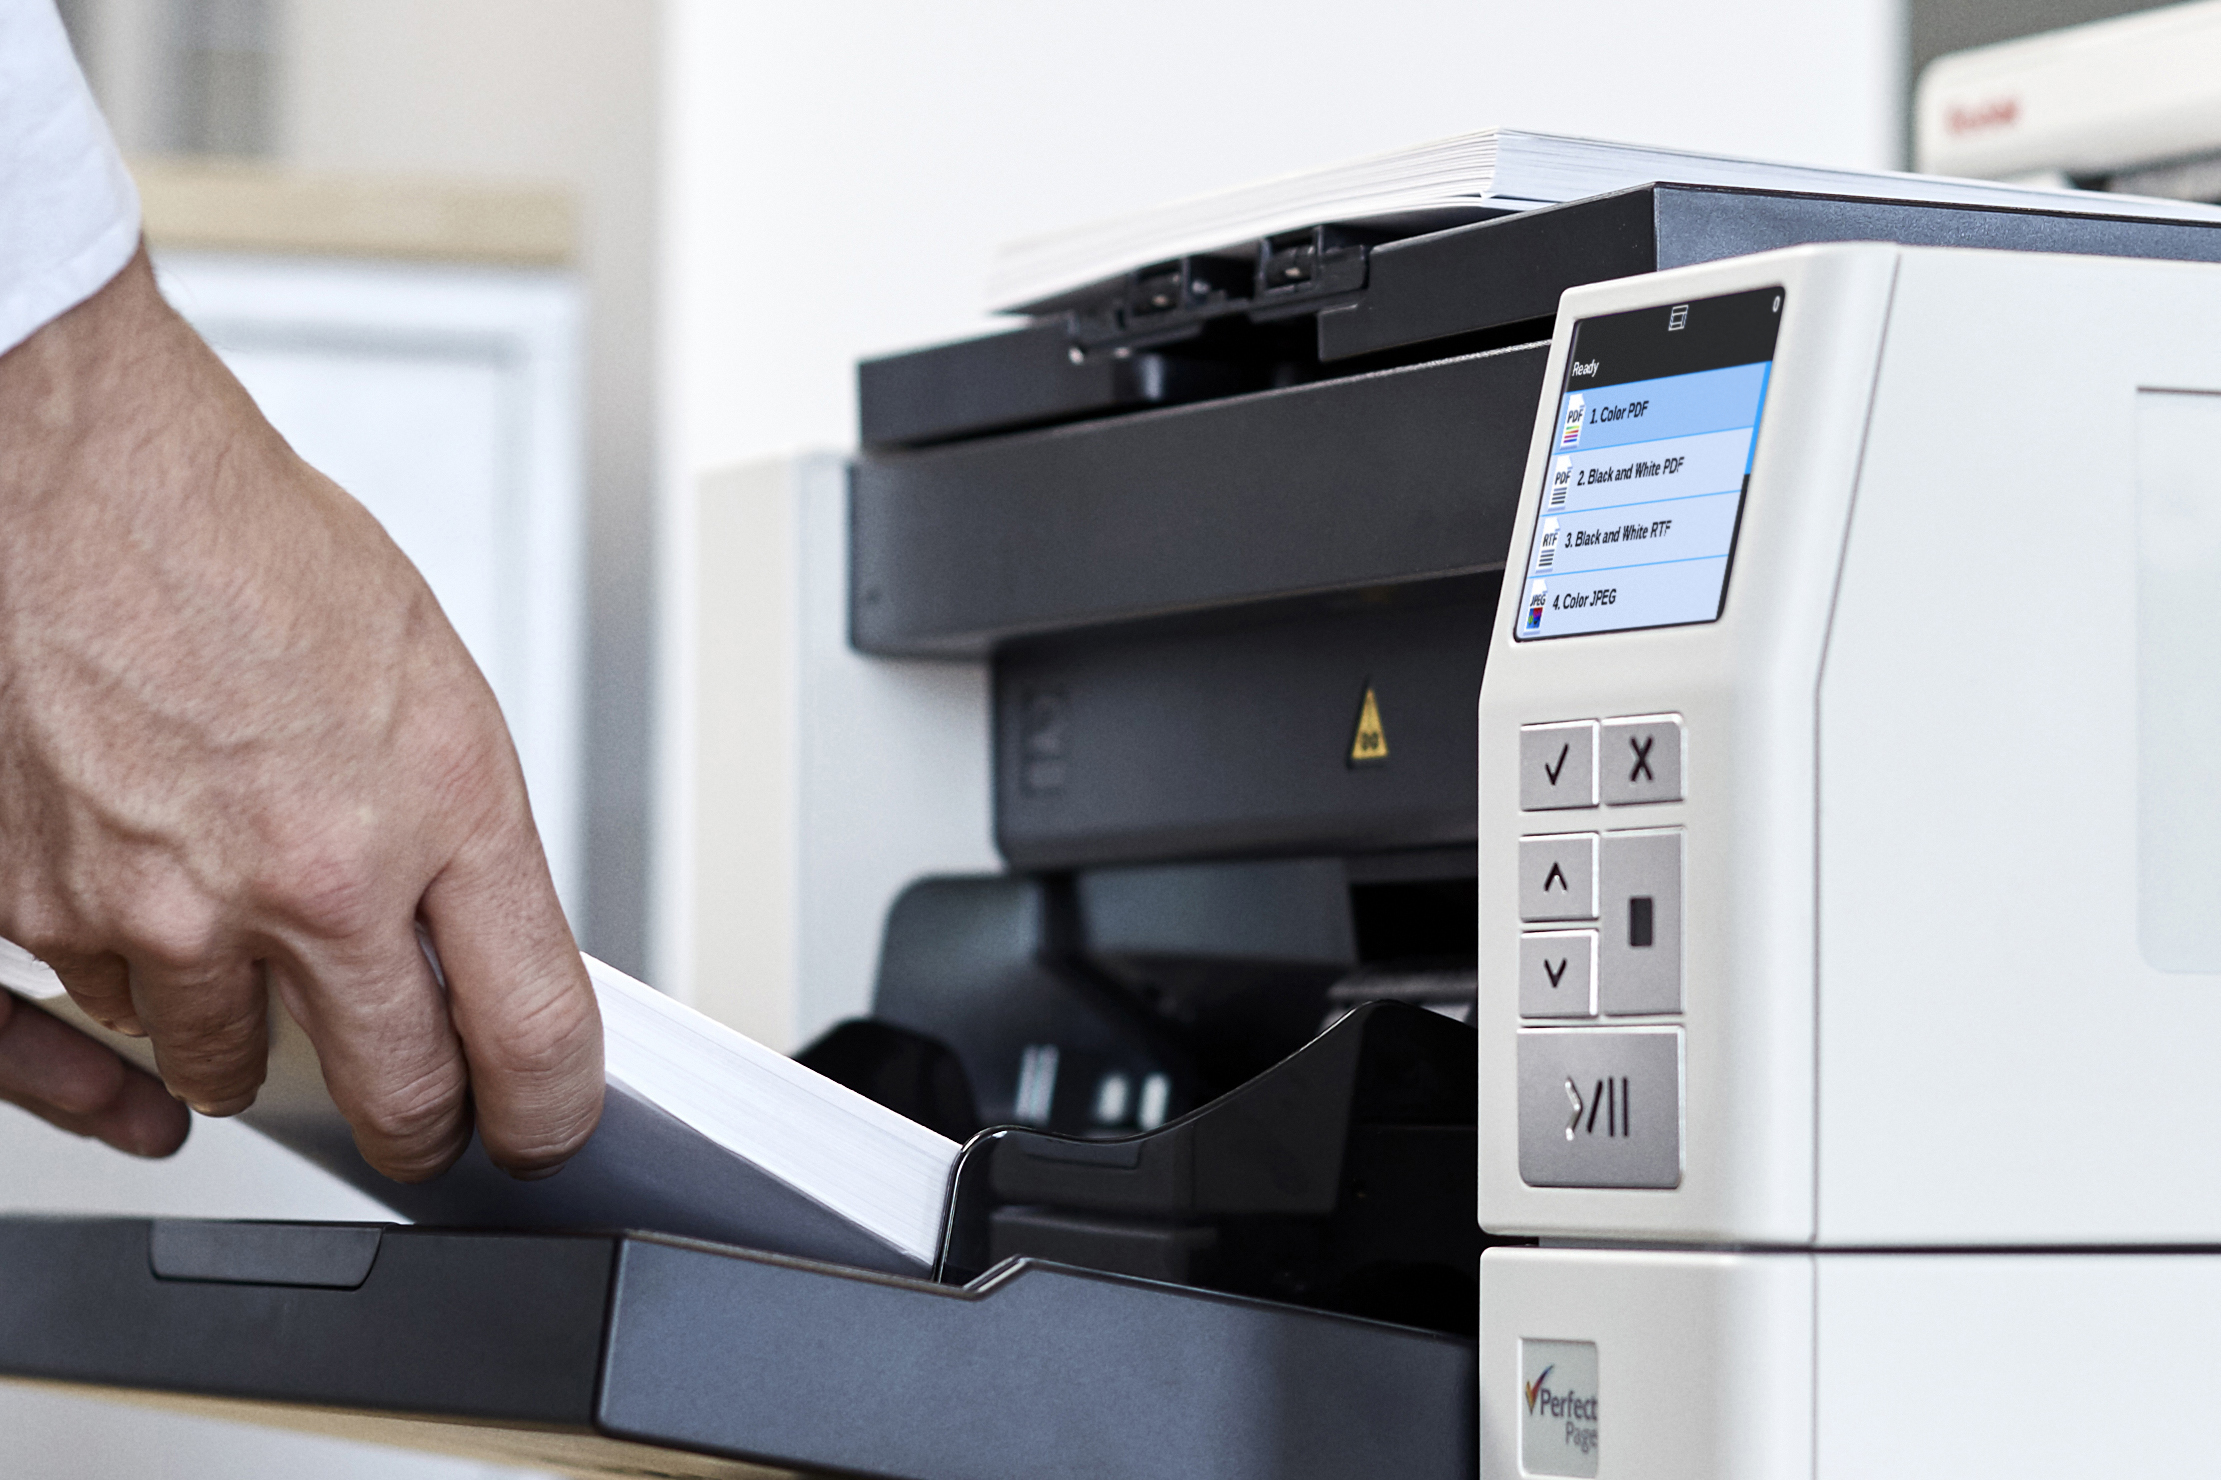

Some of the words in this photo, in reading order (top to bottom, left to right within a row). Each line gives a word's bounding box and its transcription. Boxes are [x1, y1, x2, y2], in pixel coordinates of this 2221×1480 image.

[1572, 359, 1599, 377] Ready
[1567, 409, 1583, 424] PDF
[1590, 408, 1598, 424] 1.
[1600, 405, 1627, 423] Color
[1627, 400, 1649, 418] PDF
[1555, 470, 1571, 485] PDF
[1577, 470, 1586, 486] 2.
[1588, 466, 1614, 485] Black
[1615, 463, 1634, 481] and
[1634, 460, 1661, 479] White
[1662, 456, 1685, 475] PDF
[1542, 532, 1558, 547] RTF
[1564, 532, 1573, 549] 3.
[1575, 529, 1600, 547] Black
[1602, 526, 1621, 543] and
[1622, 522, 1648, 542] White
[1650, 519, 1672, 538] RTF
[1530, 593, 1547, 607] JPEG
[1552, 594, 1561, 611] 4.
[1563, 592, 1589, 610] Color
[1590, 588, 1617, 607] JPEG
[1540, 1388, 1597, 1421] Perfect
[1565, 1421, 1598, 1455] Page
